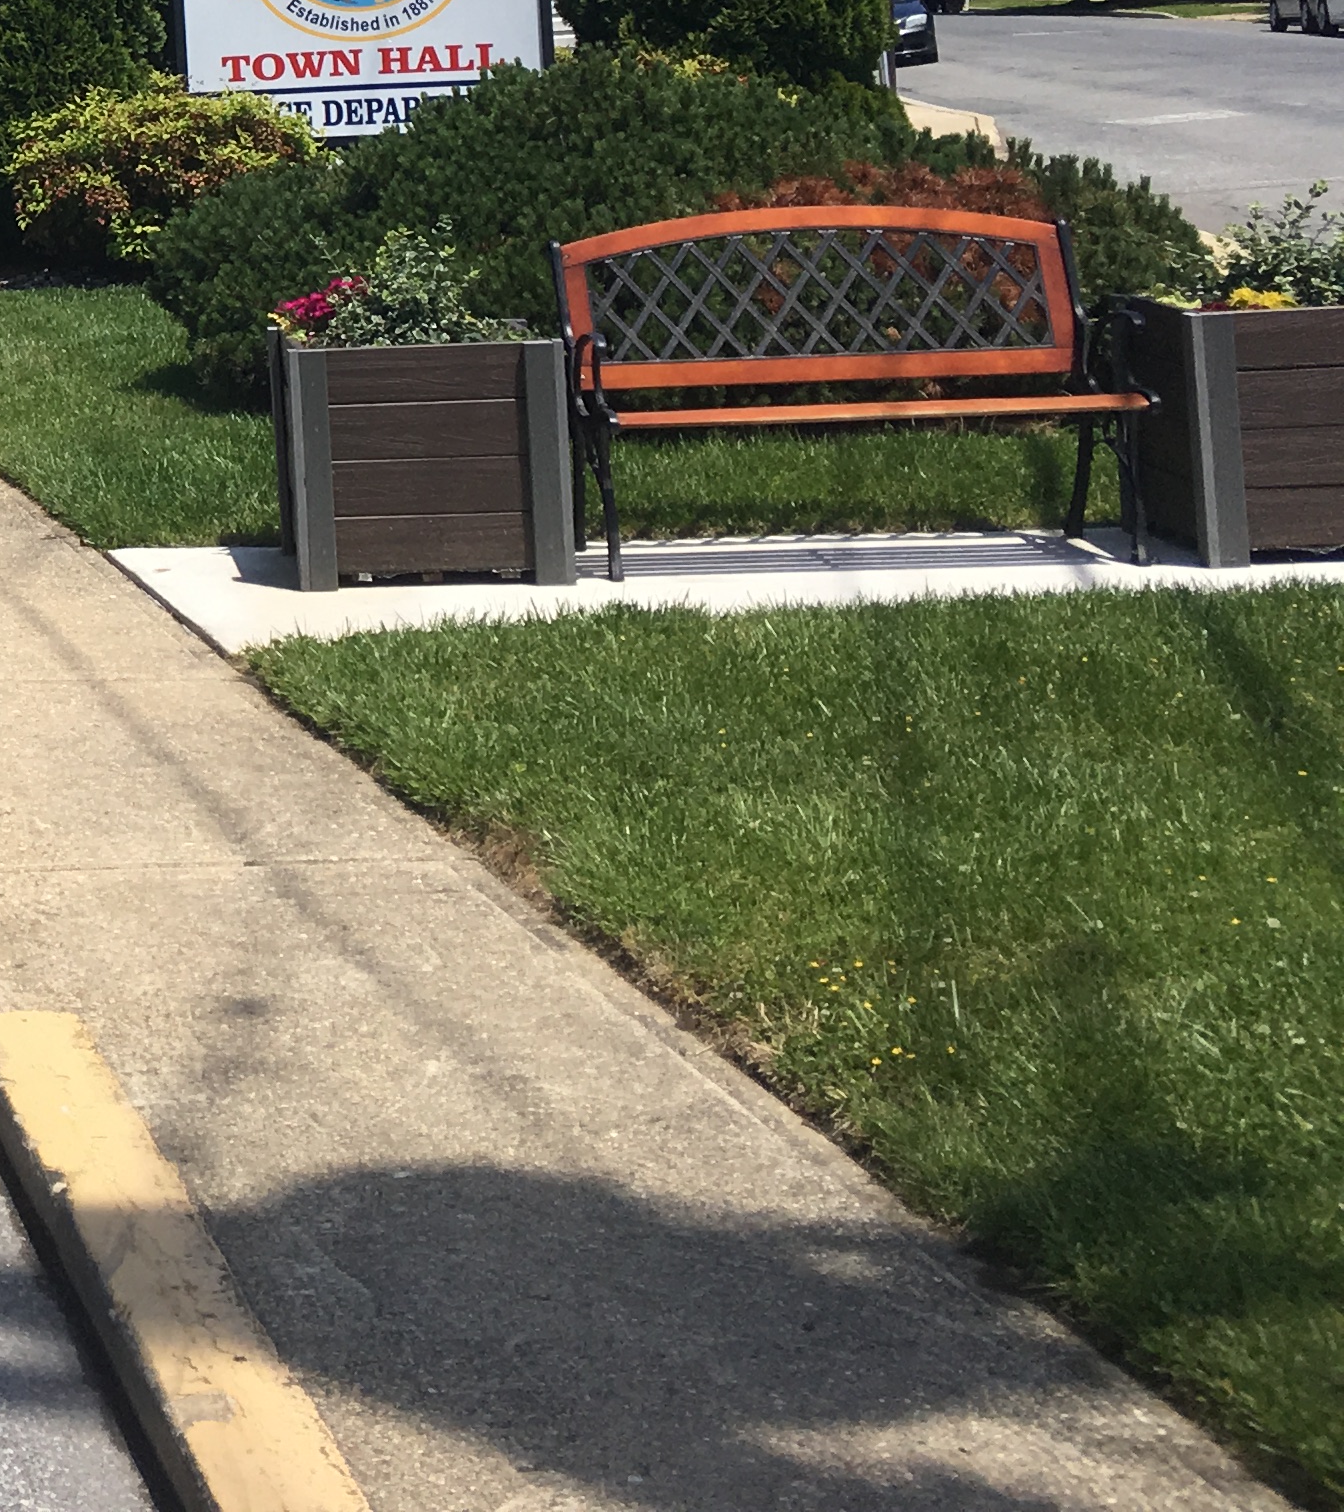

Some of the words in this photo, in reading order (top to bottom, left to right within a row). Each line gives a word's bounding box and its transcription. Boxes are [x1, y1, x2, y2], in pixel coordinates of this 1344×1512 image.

[383, 14, 401, 29] in
[221, 49, 363, 83] TOWN
[377, 43, 505, 75] HALL
[322, 96, 462, 126] DEPAR
